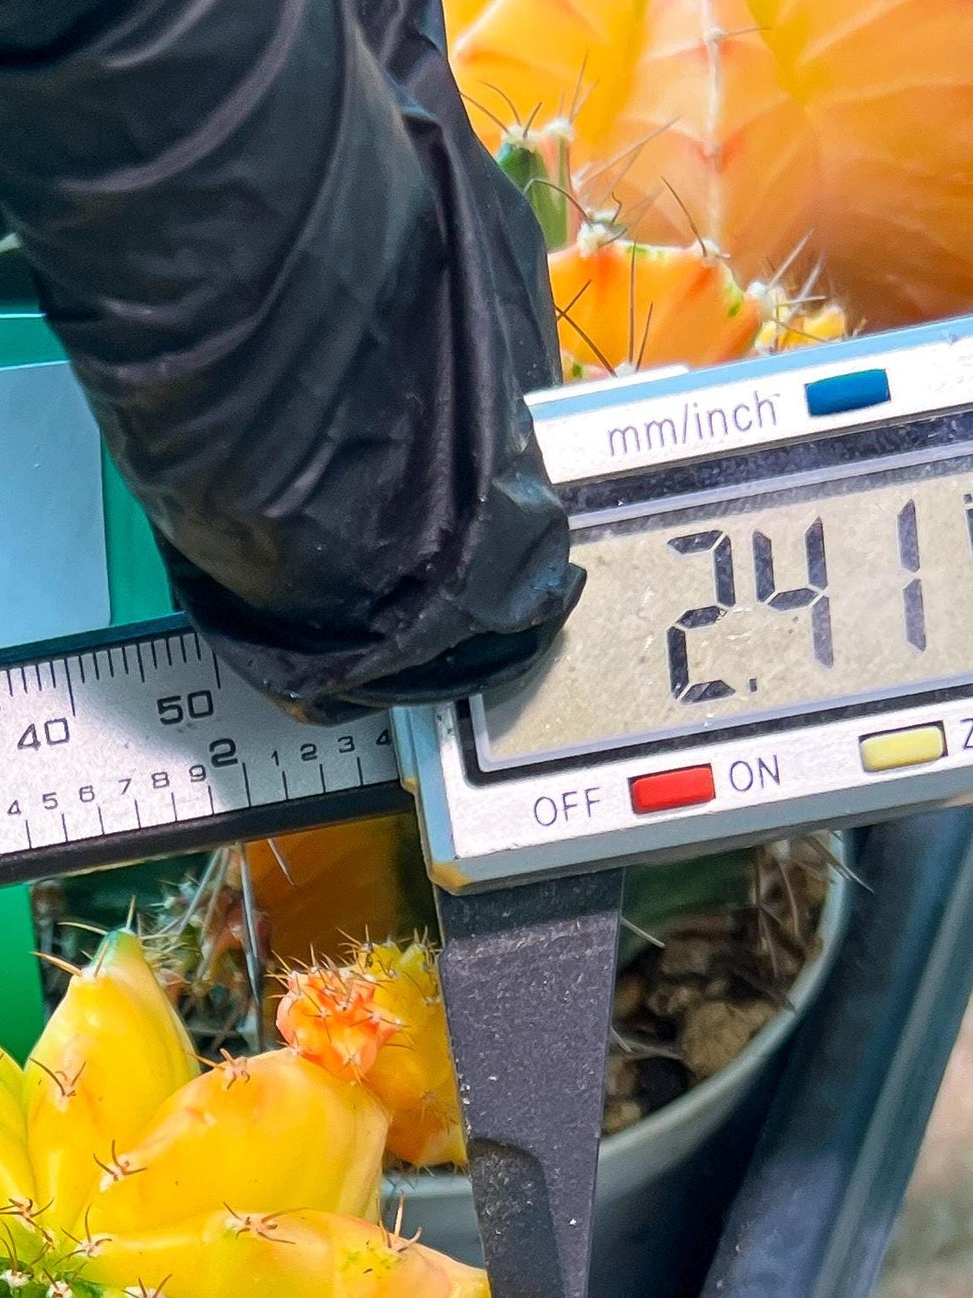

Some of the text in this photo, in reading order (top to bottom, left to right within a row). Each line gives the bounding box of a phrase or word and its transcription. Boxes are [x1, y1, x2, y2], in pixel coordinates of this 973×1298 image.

[607, 391, 780, 457] mm/inch
[17, 718, 70, 751] 40
[157, 690, 214, 725] 50
[7, 800, 22, 816] 4
[42, 793, 58, 810] 5
[79, 786, 95, 803] 6
[118, 778, 132, 796] 7
[152, 772, 170, 789] 8
[189, 765, 207, 783] 9
[209, 738, 239, 767] 2
[271, 750, 279, 766] 1
[300, 744, 318, 761] 2
[338, 737, 355, 753] 3
[375, 729, 391, 746] 4
[533, 755, 780, 827] OFF ON
